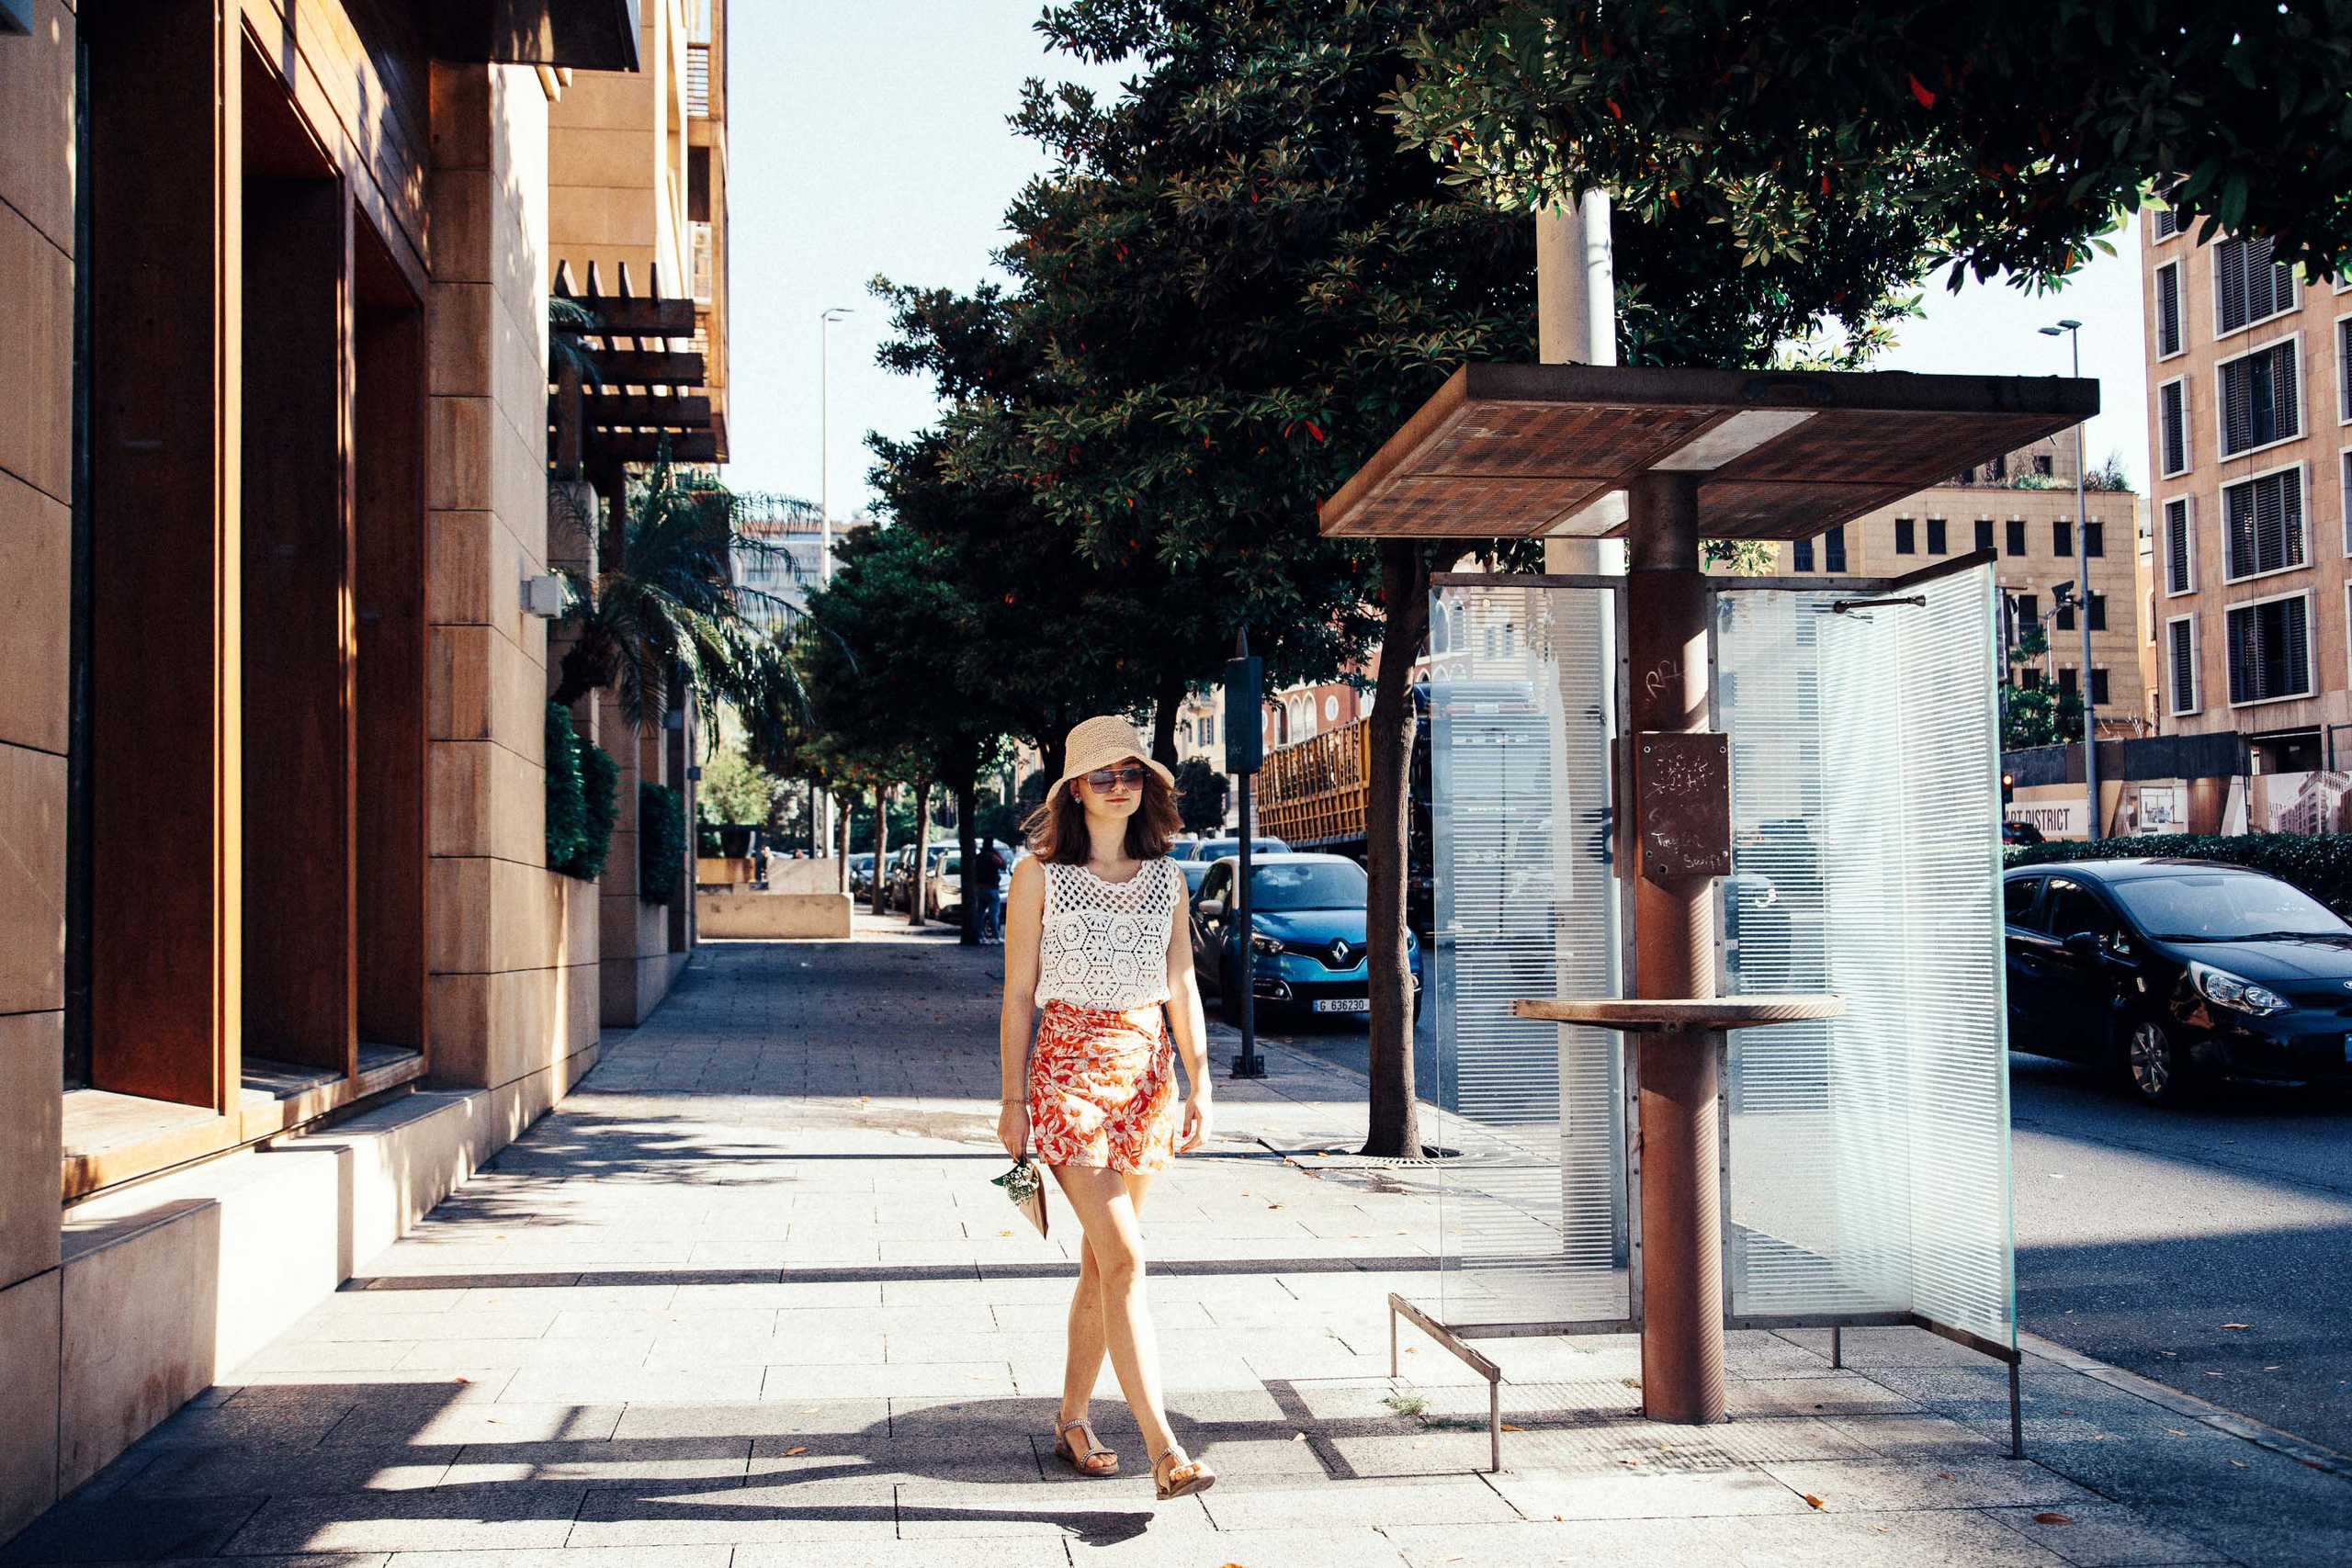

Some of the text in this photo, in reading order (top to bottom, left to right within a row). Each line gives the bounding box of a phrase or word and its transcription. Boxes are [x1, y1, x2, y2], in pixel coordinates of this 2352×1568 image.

[2026, 808, 2070, 830] DISTRICT
[1320, 999, 1364, 1010] G 636230
